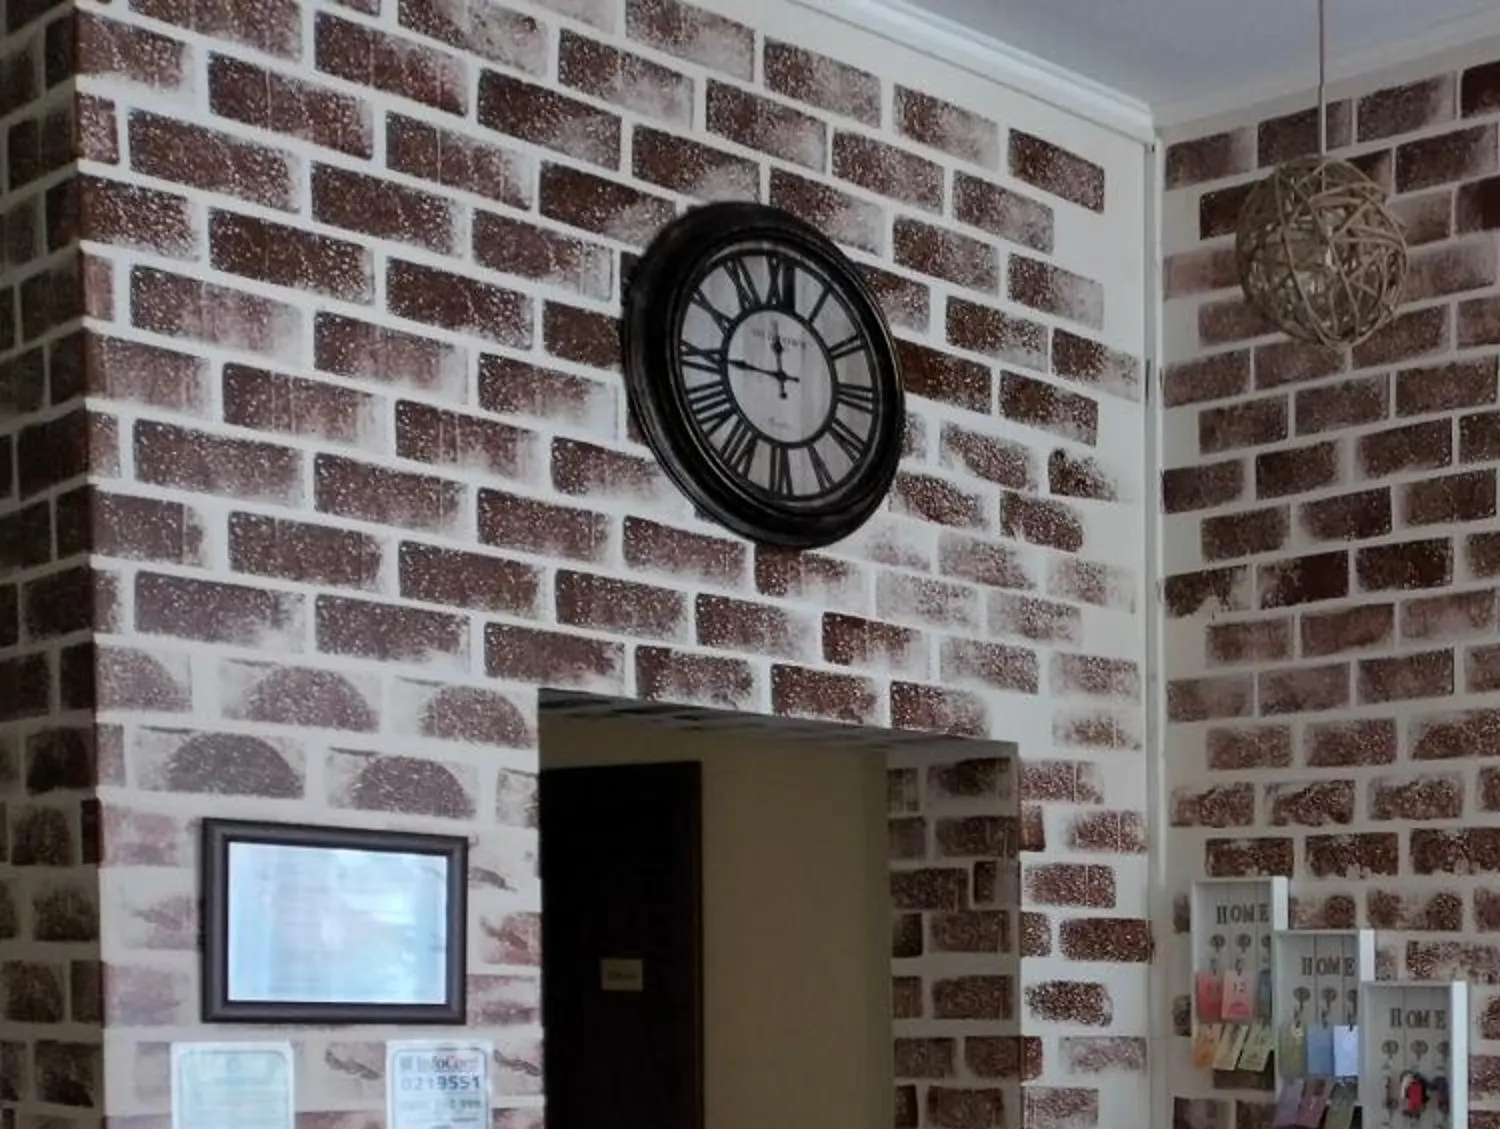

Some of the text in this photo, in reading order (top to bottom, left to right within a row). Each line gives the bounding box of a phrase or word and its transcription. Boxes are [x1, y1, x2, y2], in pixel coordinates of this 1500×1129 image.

[1216, 903, 1270, 925] HOME
[1301, 956, 1356, 977] HOME
[1390, 1007, 1446, 1029] HOME
